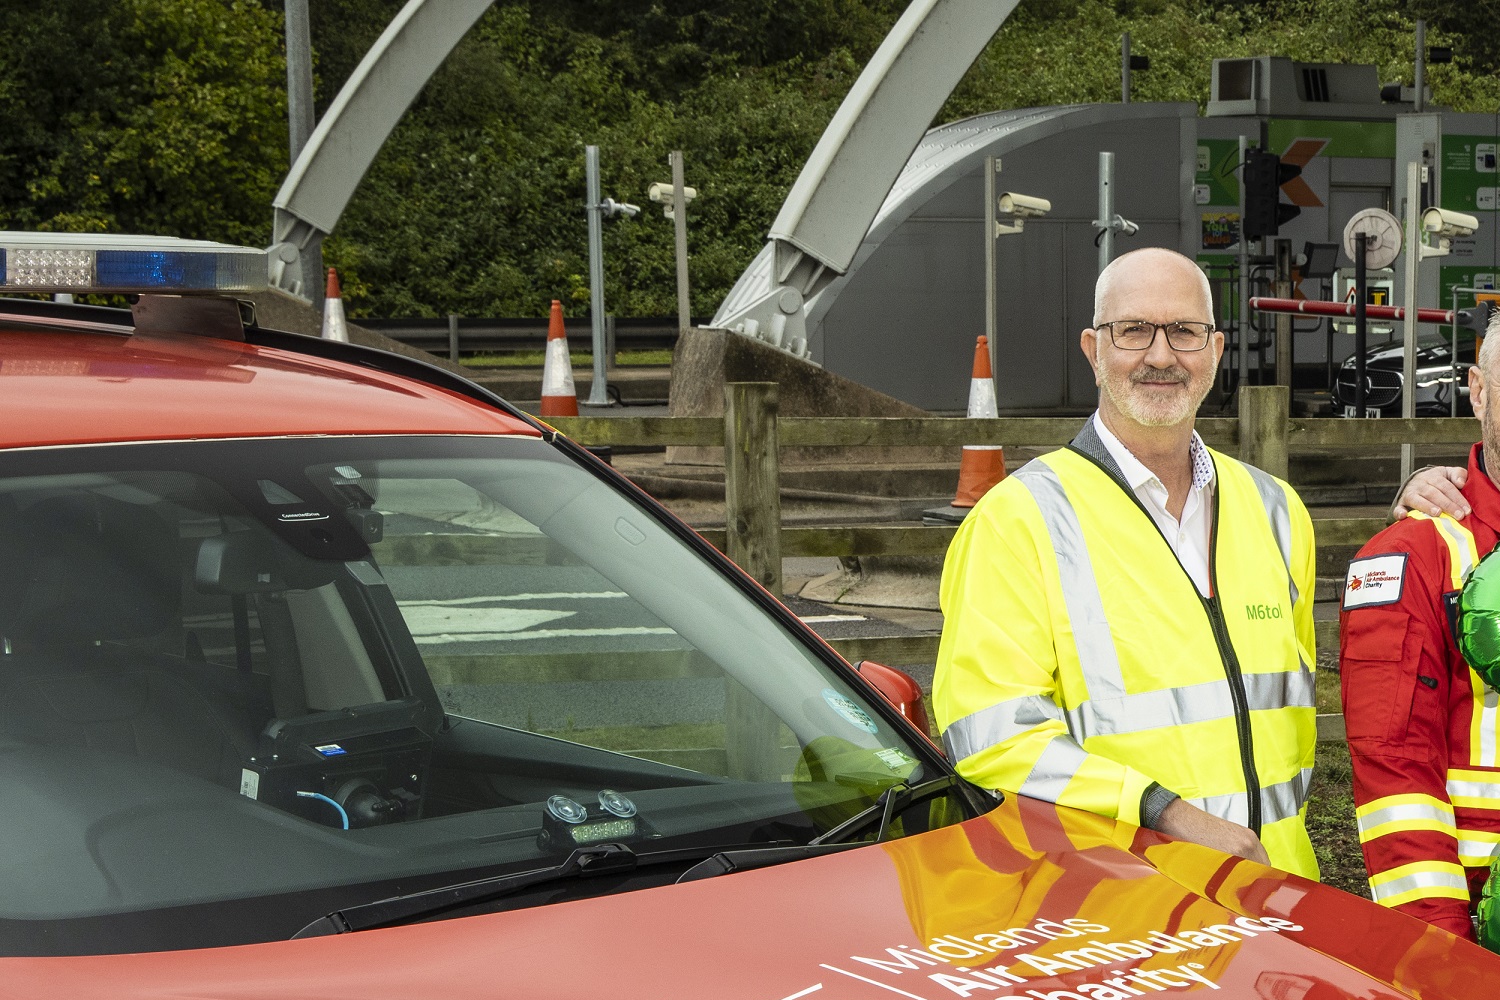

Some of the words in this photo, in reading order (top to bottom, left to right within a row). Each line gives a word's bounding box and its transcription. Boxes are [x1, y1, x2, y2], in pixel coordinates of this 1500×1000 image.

[850, 918, 1110, 974] Midlands
[928, 966, 1028, 998] Air
[1014, 916, 1304, 977] Ambulance
